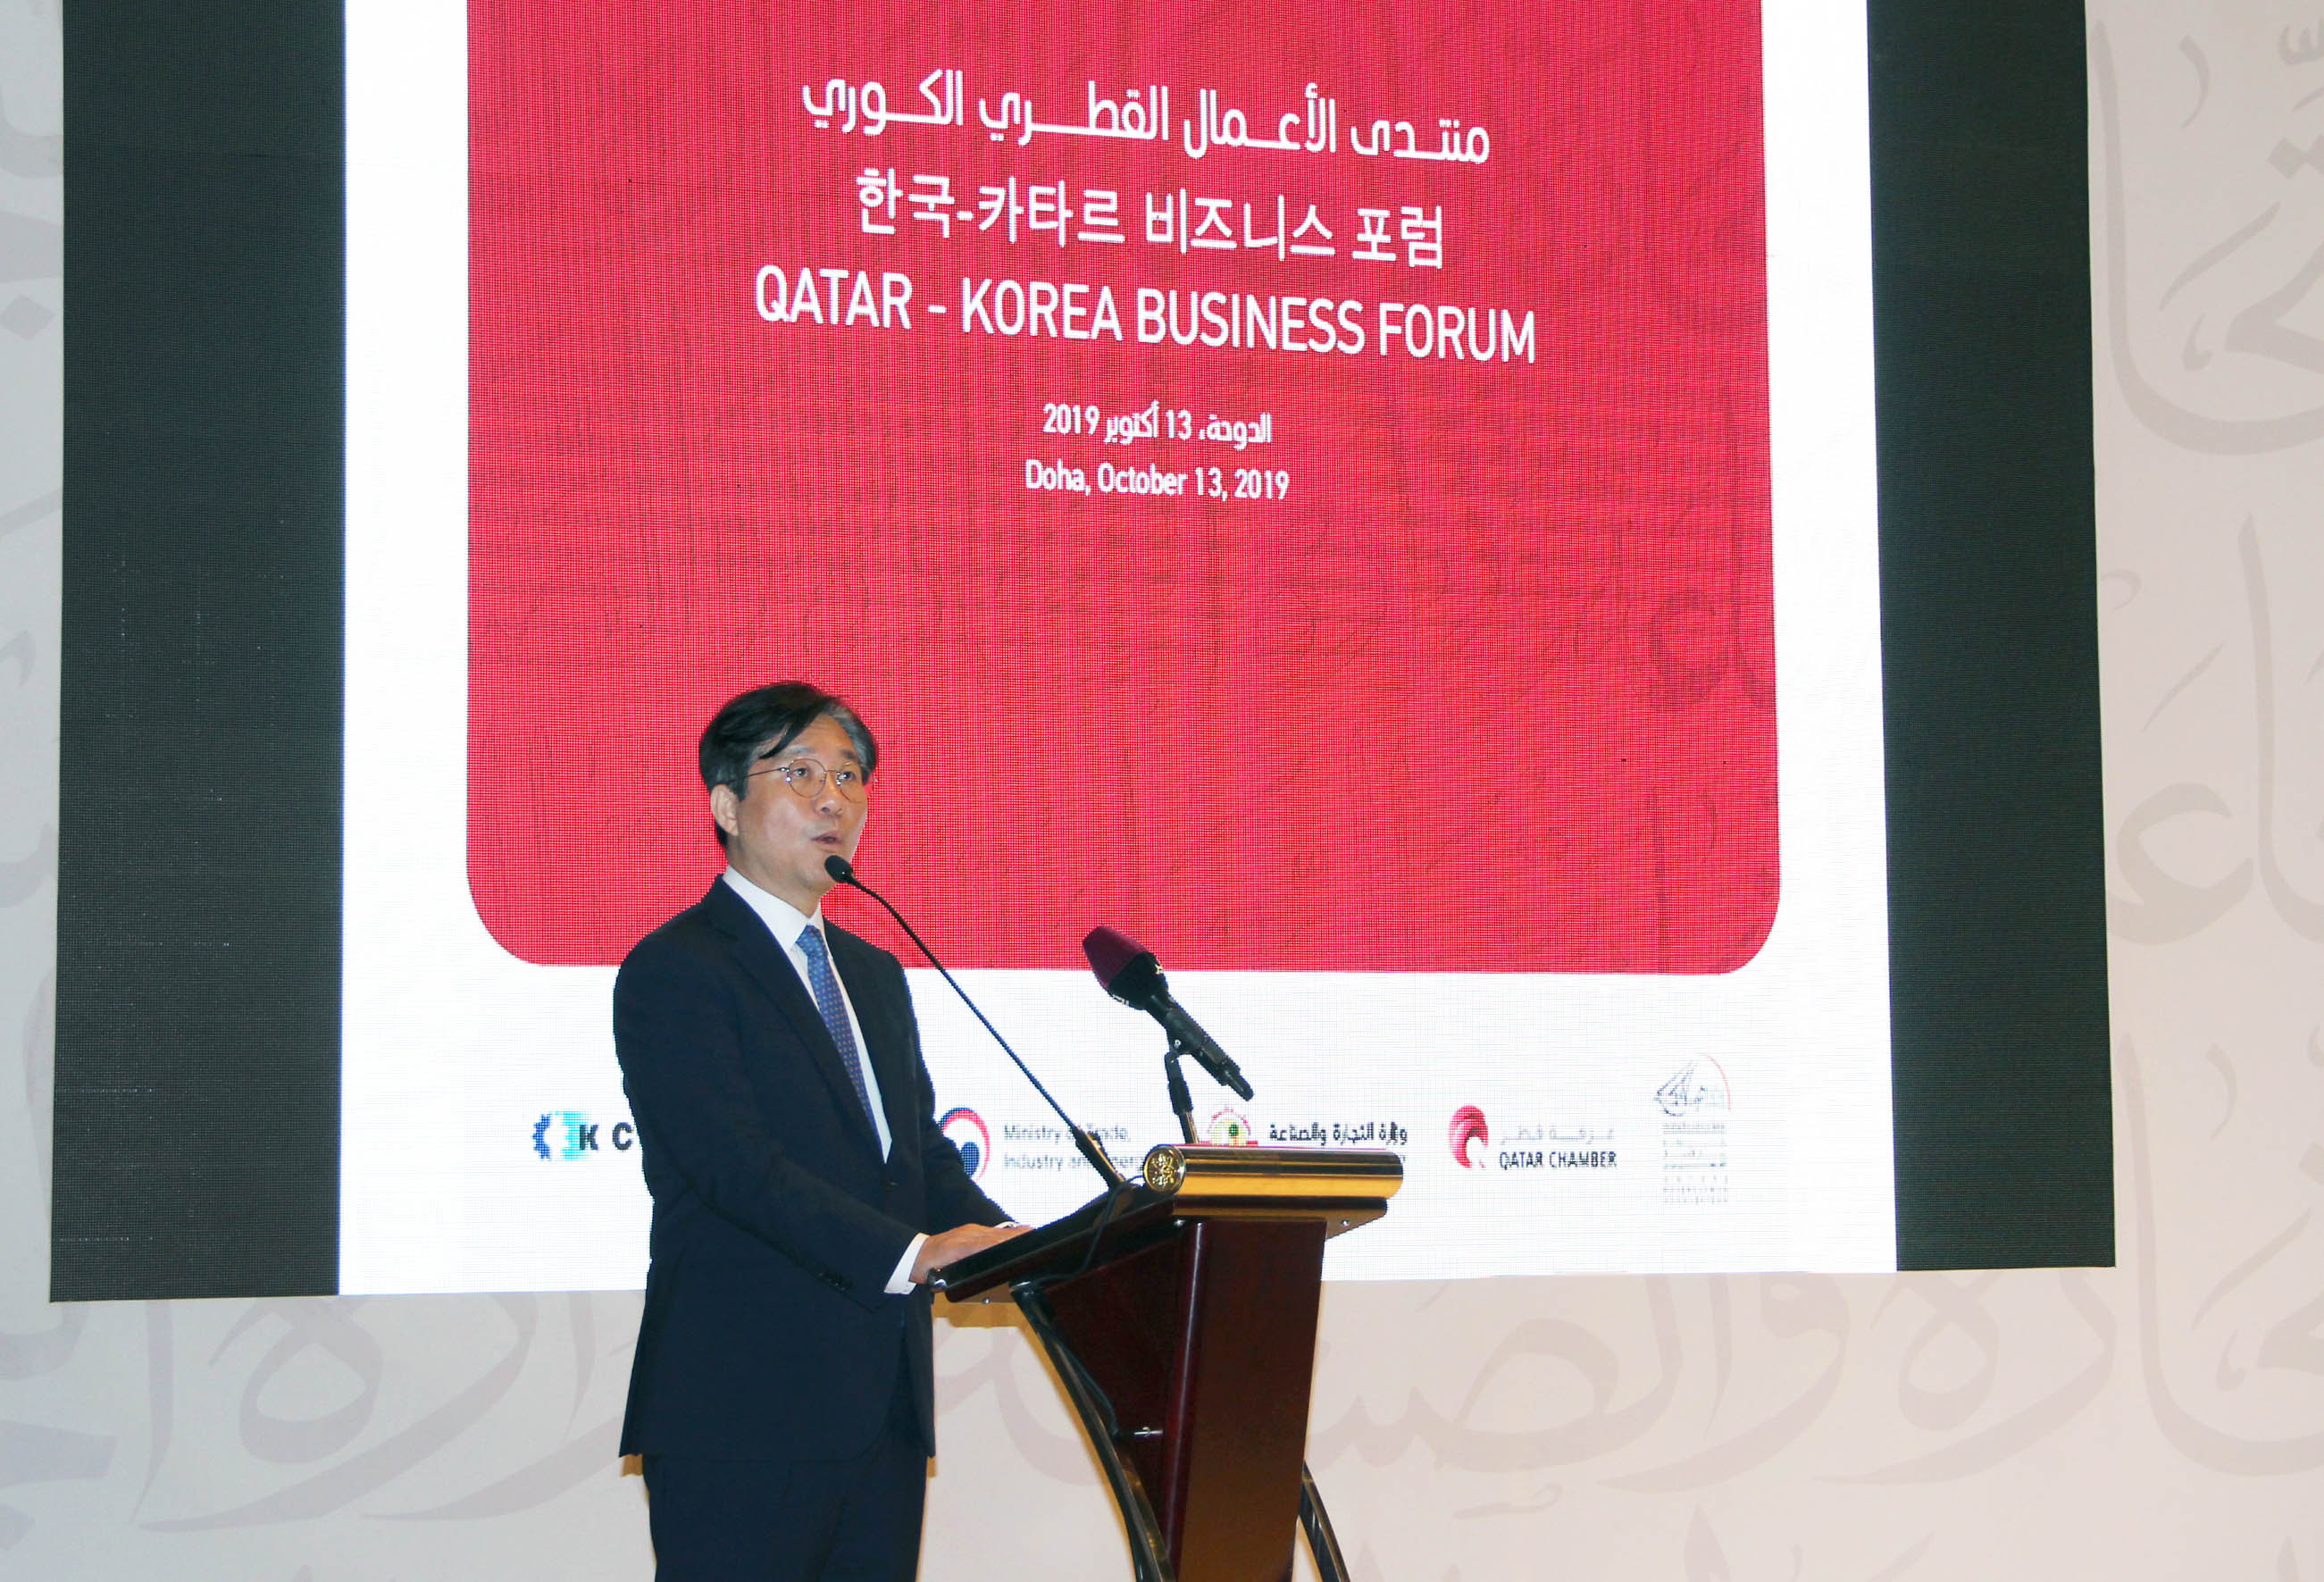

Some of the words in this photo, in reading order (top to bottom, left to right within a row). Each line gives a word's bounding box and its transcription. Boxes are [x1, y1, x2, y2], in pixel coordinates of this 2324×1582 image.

[801, 69, 964, 136] الكوري
[979, 80, 1170, 146] القطري
[1183, 82, 1337, 159] الأعمال
[1350, 118, 1491, 165] منتدى
[855, 167, 1126, 248] 한국-카타르
[1144, 188, 1336, 261] 비즈니스
[1351, 205, 1444, 269] 포럼
[756, 264, 914, 330] QATAR
[962, 277, 1124, 341] KOREA
[1137, 288, 1367, 355] BUSINESS
[1379, 302, 1536, 364] FORUM
[1043, 403, 1100, 436] 2019
[1103, 398, 1160, 446] أكتوبر
[1165, 408, 1192, 440] 13
[1025, 458, 1091, 496] Doha,
[1097, 462, 1189, 496] October
[1195, 466, 1229, 502] 13,
[1234, 468, 1290, 500] 2019
[1004, 1124, 1062, 1144] Ministry
[1004, 1153, 1064, 1171] Industry
[1499, 1151, 1544, 1171] QATAR
[1548, 1150, 1618, 1169] CHAMBER
